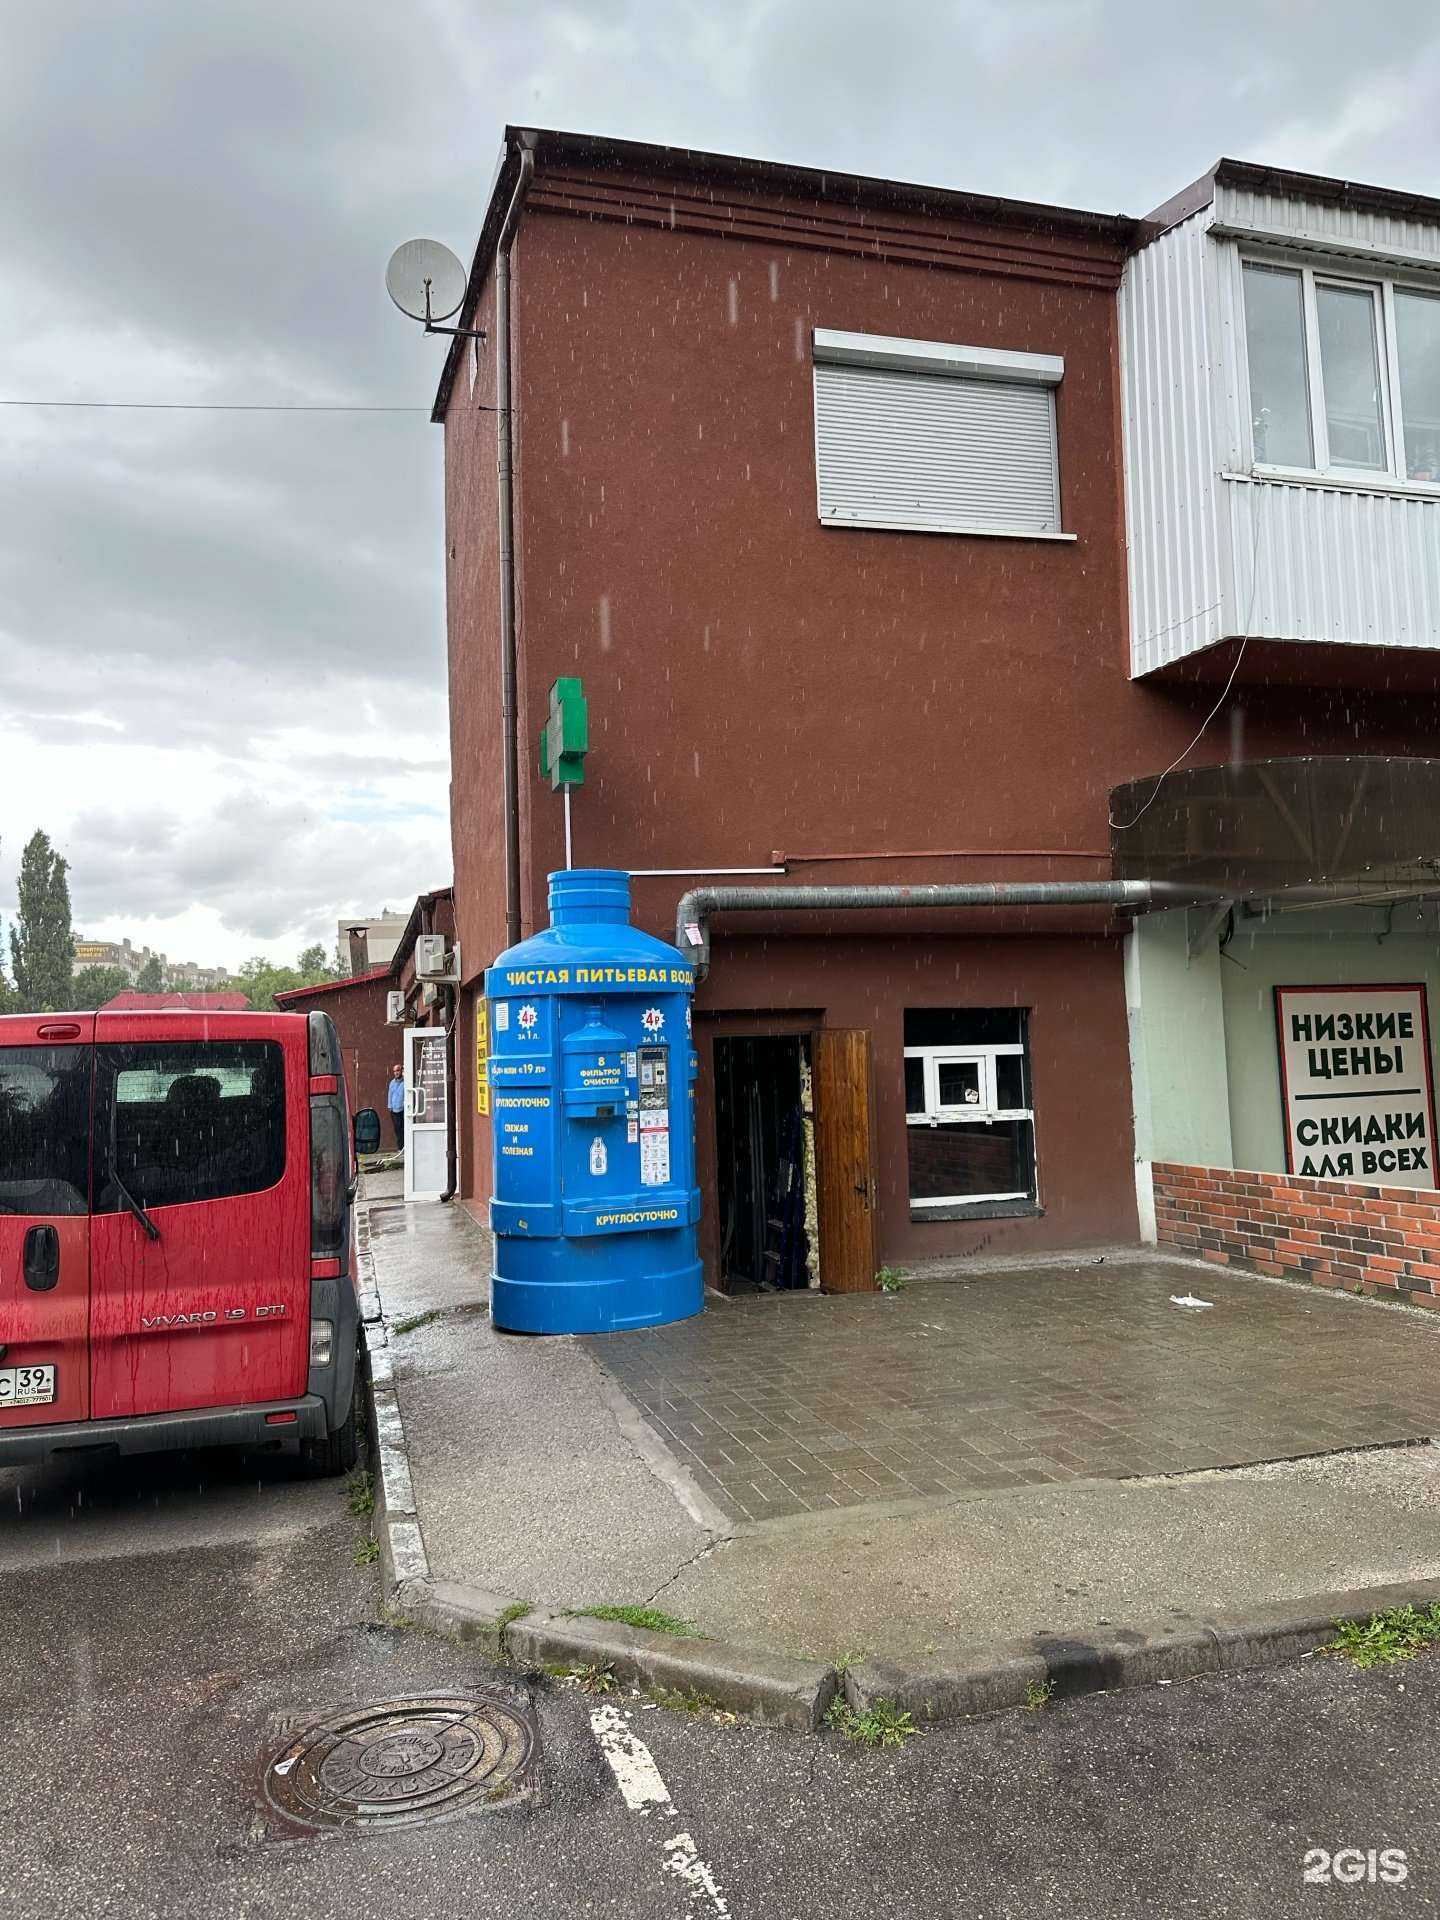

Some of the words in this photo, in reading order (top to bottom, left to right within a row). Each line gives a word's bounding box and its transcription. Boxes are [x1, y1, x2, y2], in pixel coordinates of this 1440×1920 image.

[507, 970, 569, 986] ЧИСТАЯ
[576, 968, 667, 984] ПИТЬЕВАЯ
[1291, 1012, 1414, 1041] НИЗКИЕ
[598, 1057, 605, 1066] 8
[1308, 1045, 1404, 1079] ЦЕНЫ
[580, 1069, 621, 1077] ФИЛЬТРОВ
[583, 1078, 620, 1087] ОЧИСТКИ
[1296, 1112, 1426, 1146] СКИДКИ
[1299, 1153, 1354, 1177] ДЛЯ
[1361, 1147, 1429, 1174] ВСЕХ
[596, 1209, 678, 1226] КРУГЛОСУТОЧНО
[141, 1311, 217, 1328] VIVARO
[255, 1304, 285, 1317] DTI
[20, 1369, 45, 1388] 39
[17, 1387, 37, 1395] RUS
